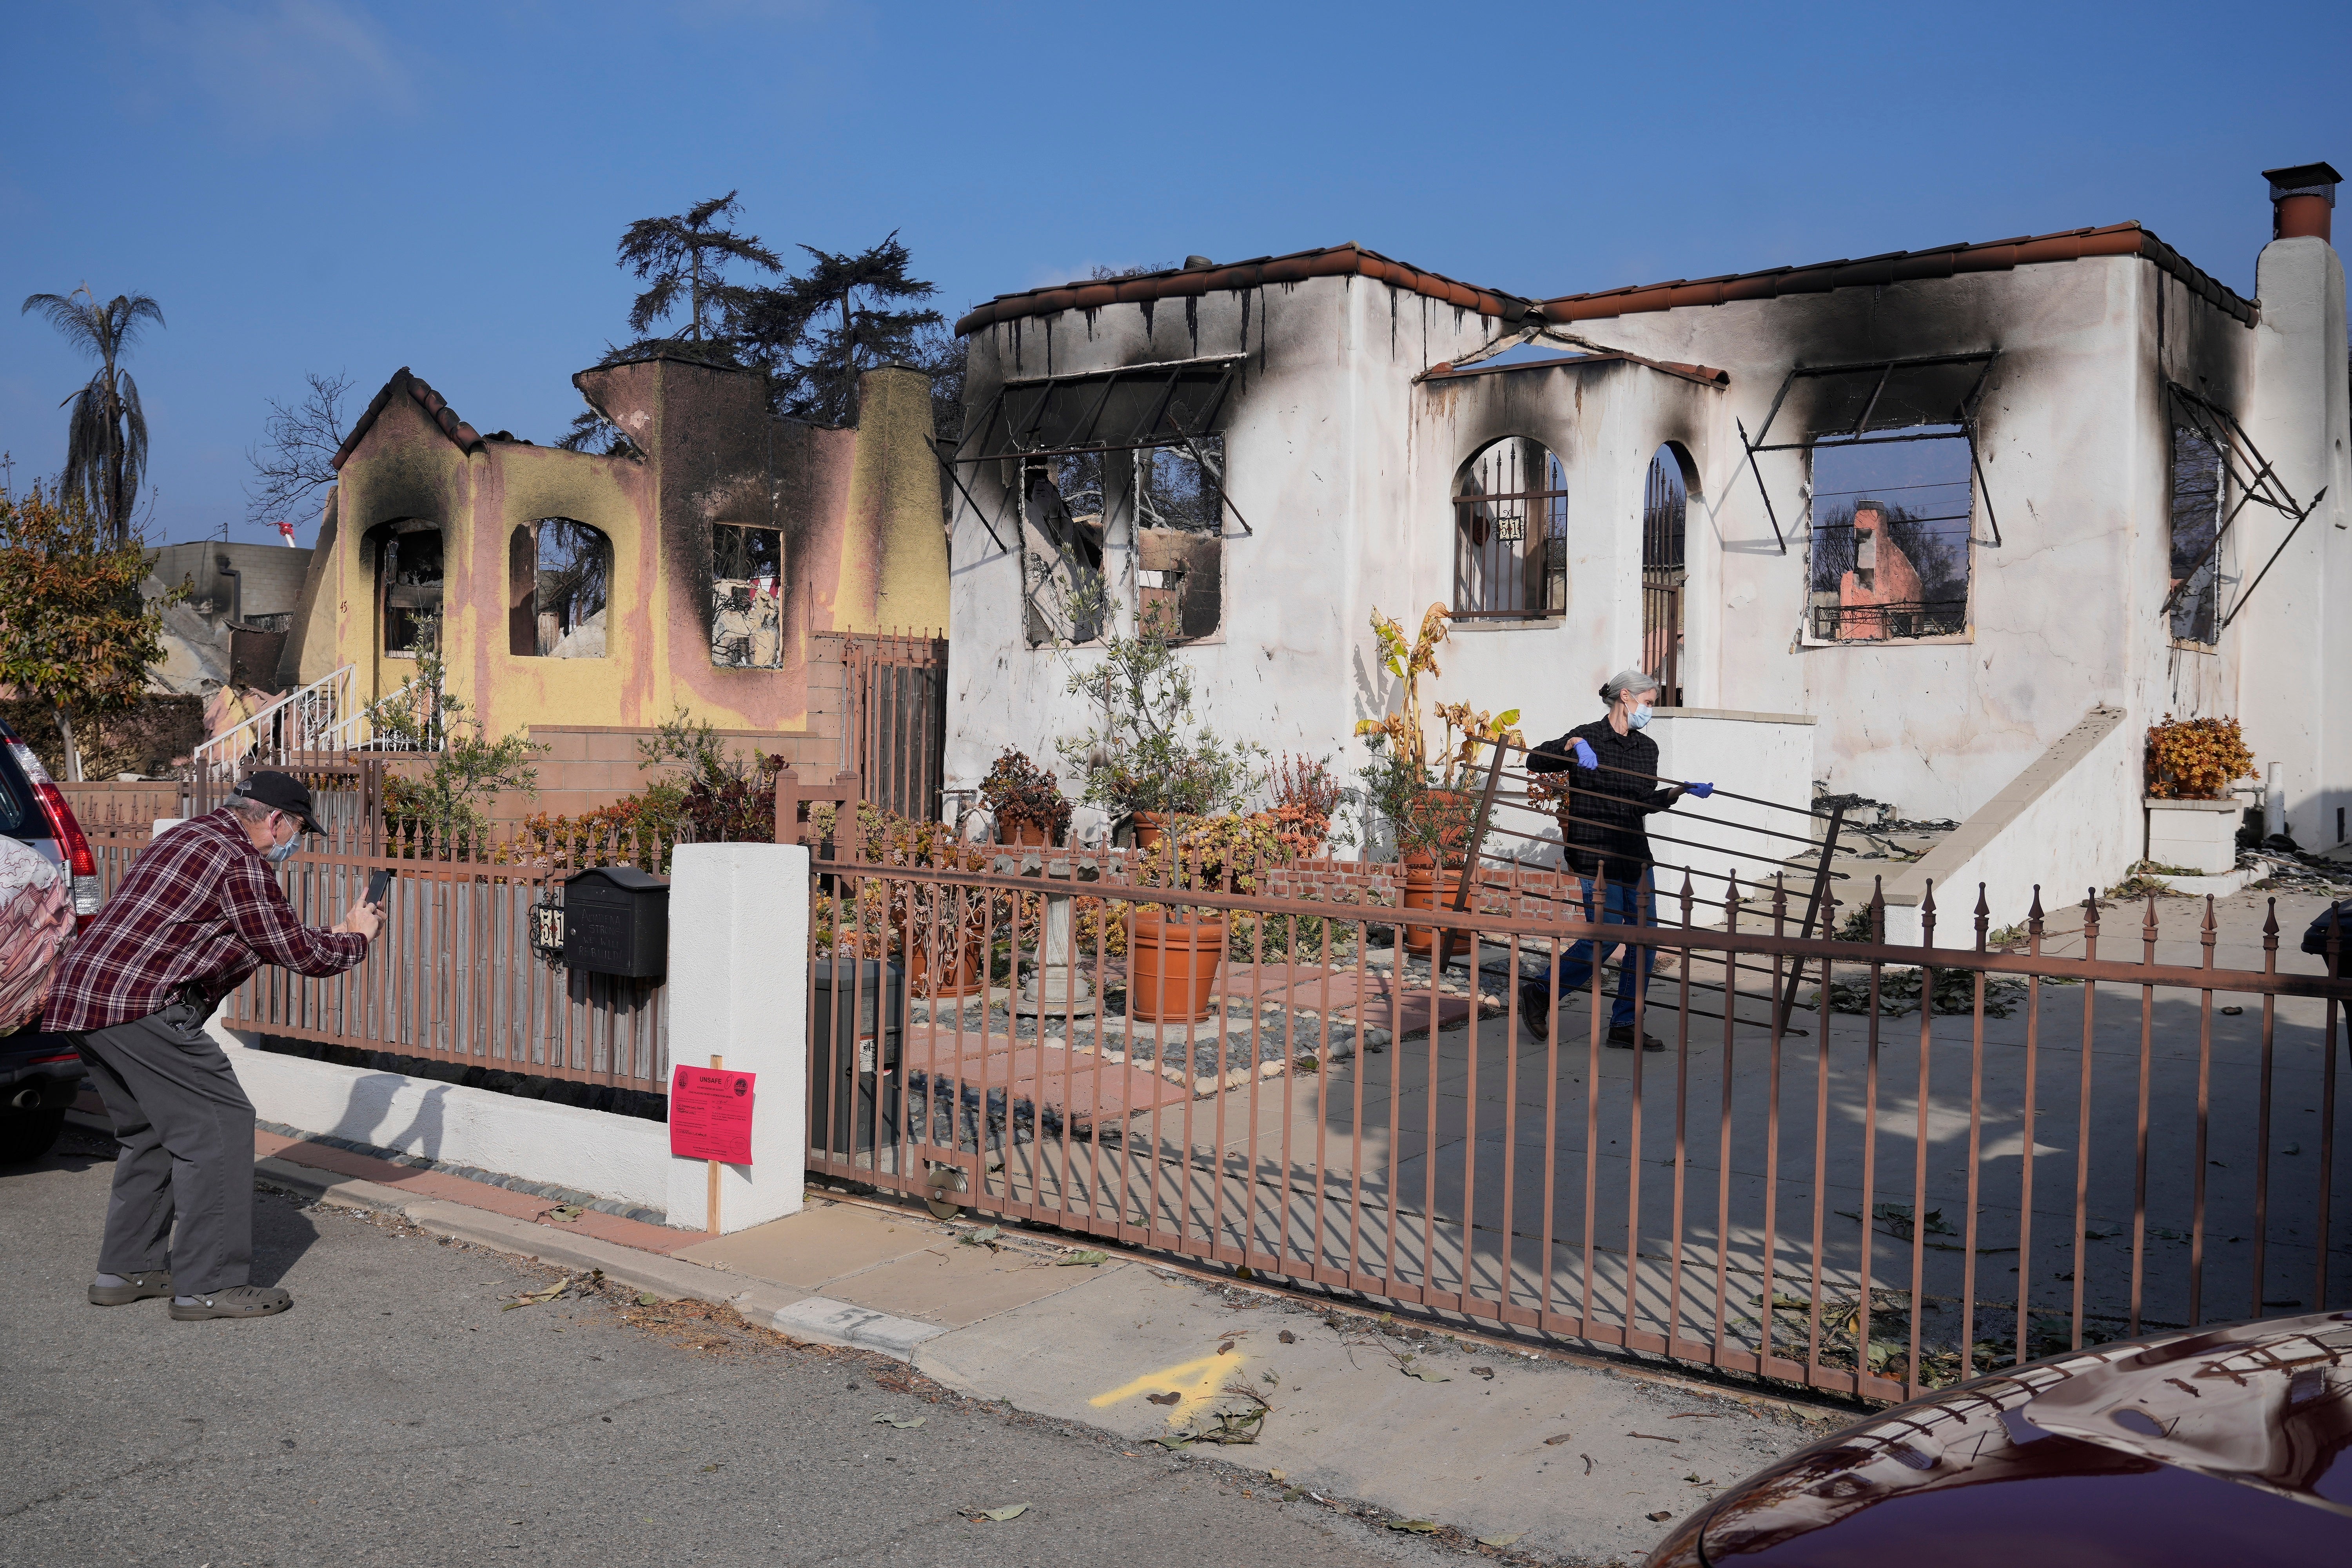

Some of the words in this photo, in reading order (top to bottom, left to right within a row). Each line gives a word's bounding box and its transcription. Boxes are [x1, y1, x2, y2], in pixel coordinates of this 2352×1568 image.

[1502, 521, 1518, 536] 51
[340, 600, 347, 613] 45
[543, 914, 564, 942] 51
[601, 937, 621, 949] WILL
[700, 1076, 722, 1084] UNSAFE
